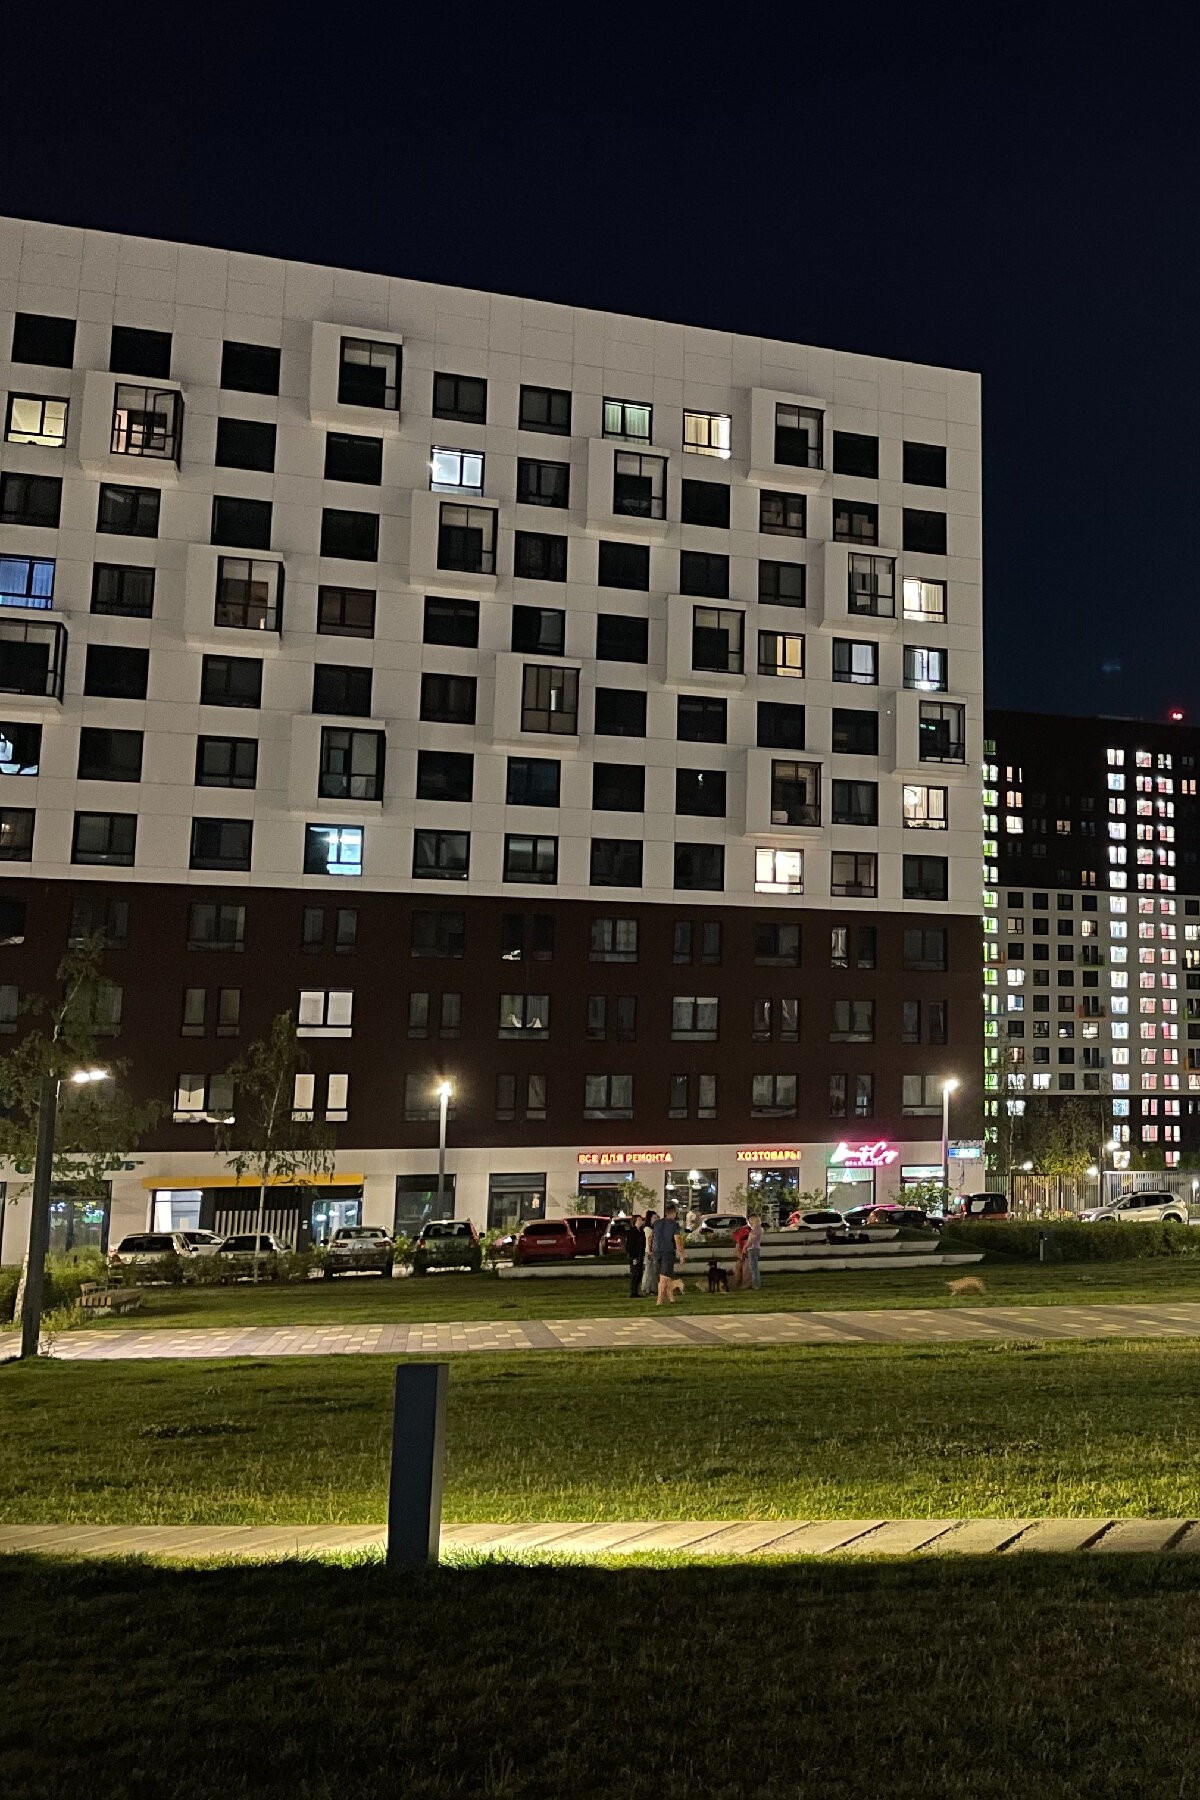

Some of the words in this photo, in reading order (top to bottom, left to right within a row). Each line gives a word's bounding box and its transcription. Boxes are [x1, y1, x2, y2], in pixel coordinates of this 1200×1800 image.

[578, 1154, 599, 1164] ВСЕ
[600, 1154, 624, 1165] ДЛЯ
[625, 1152, 673, 1163] РЕМОНТА
[736, 1150, 802, 1162] ХОЗТОВАРЫ
